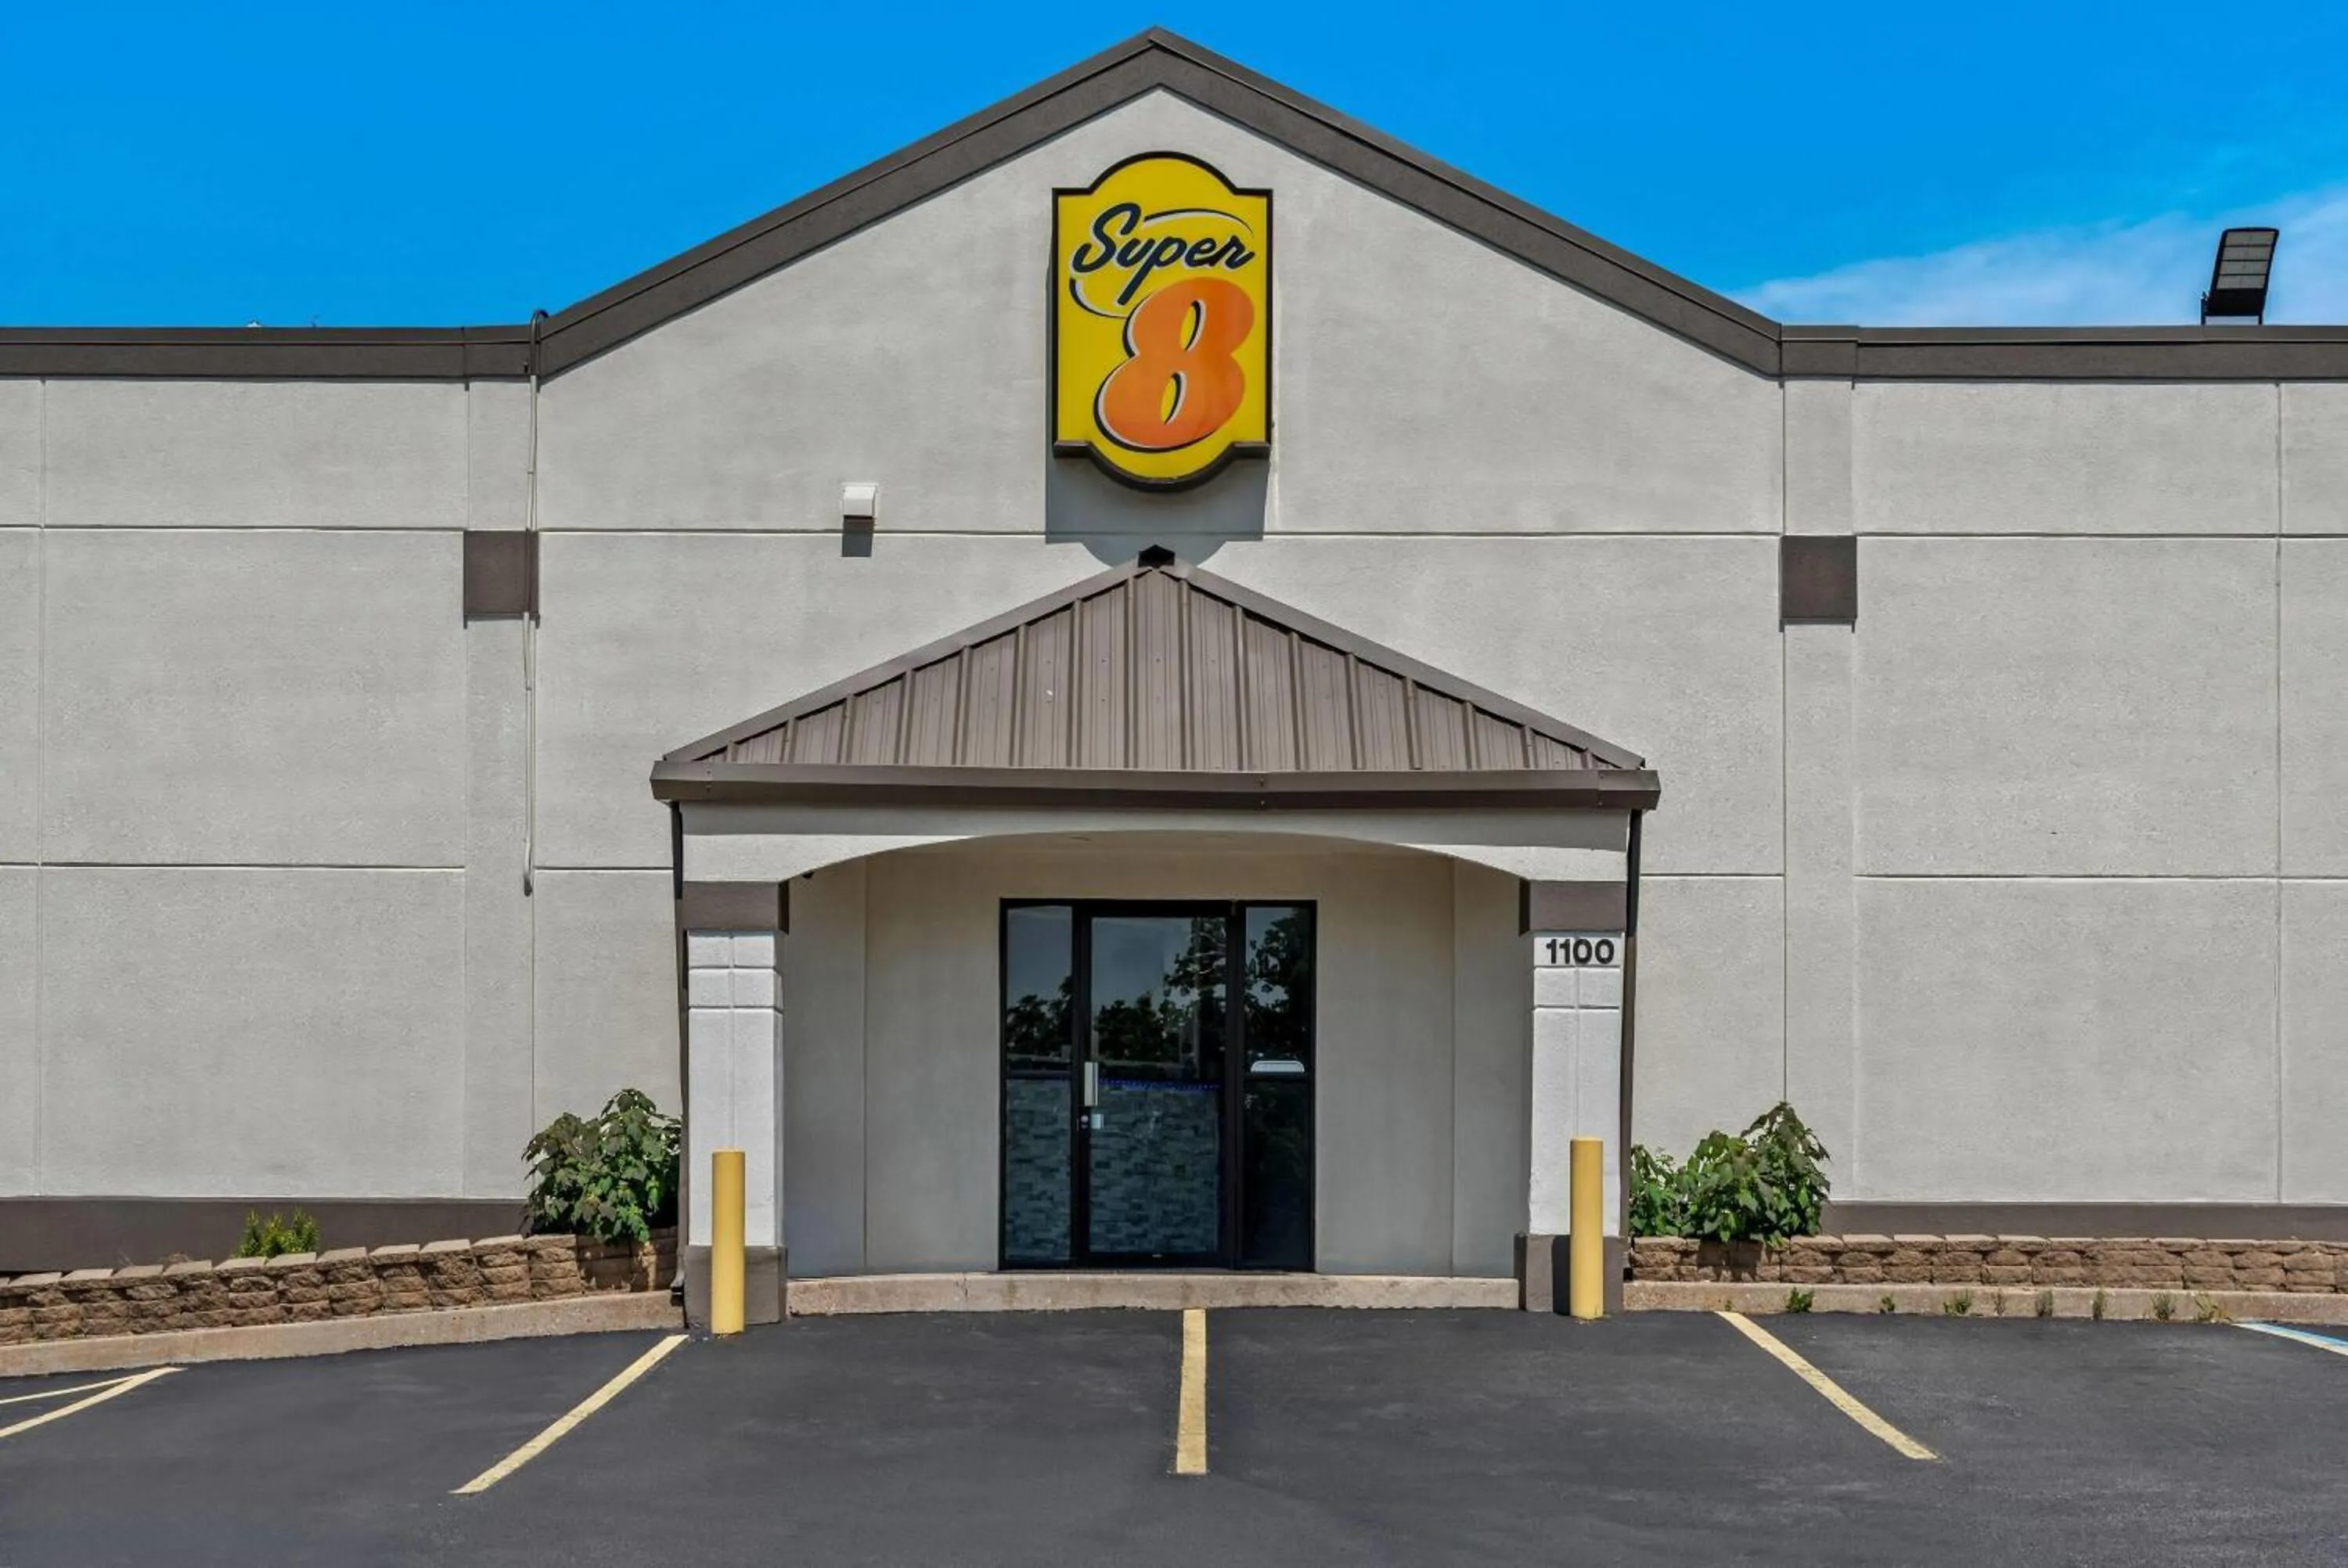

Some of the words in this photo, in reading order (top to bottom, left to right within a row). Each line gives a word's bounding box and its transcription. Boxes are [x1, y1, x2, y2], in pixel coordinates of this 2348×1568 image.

[1072, 202, 1255, 305] Super
[1093, 276, 1255, 453] 8
[1546, 938, 1615, 965] 1100
